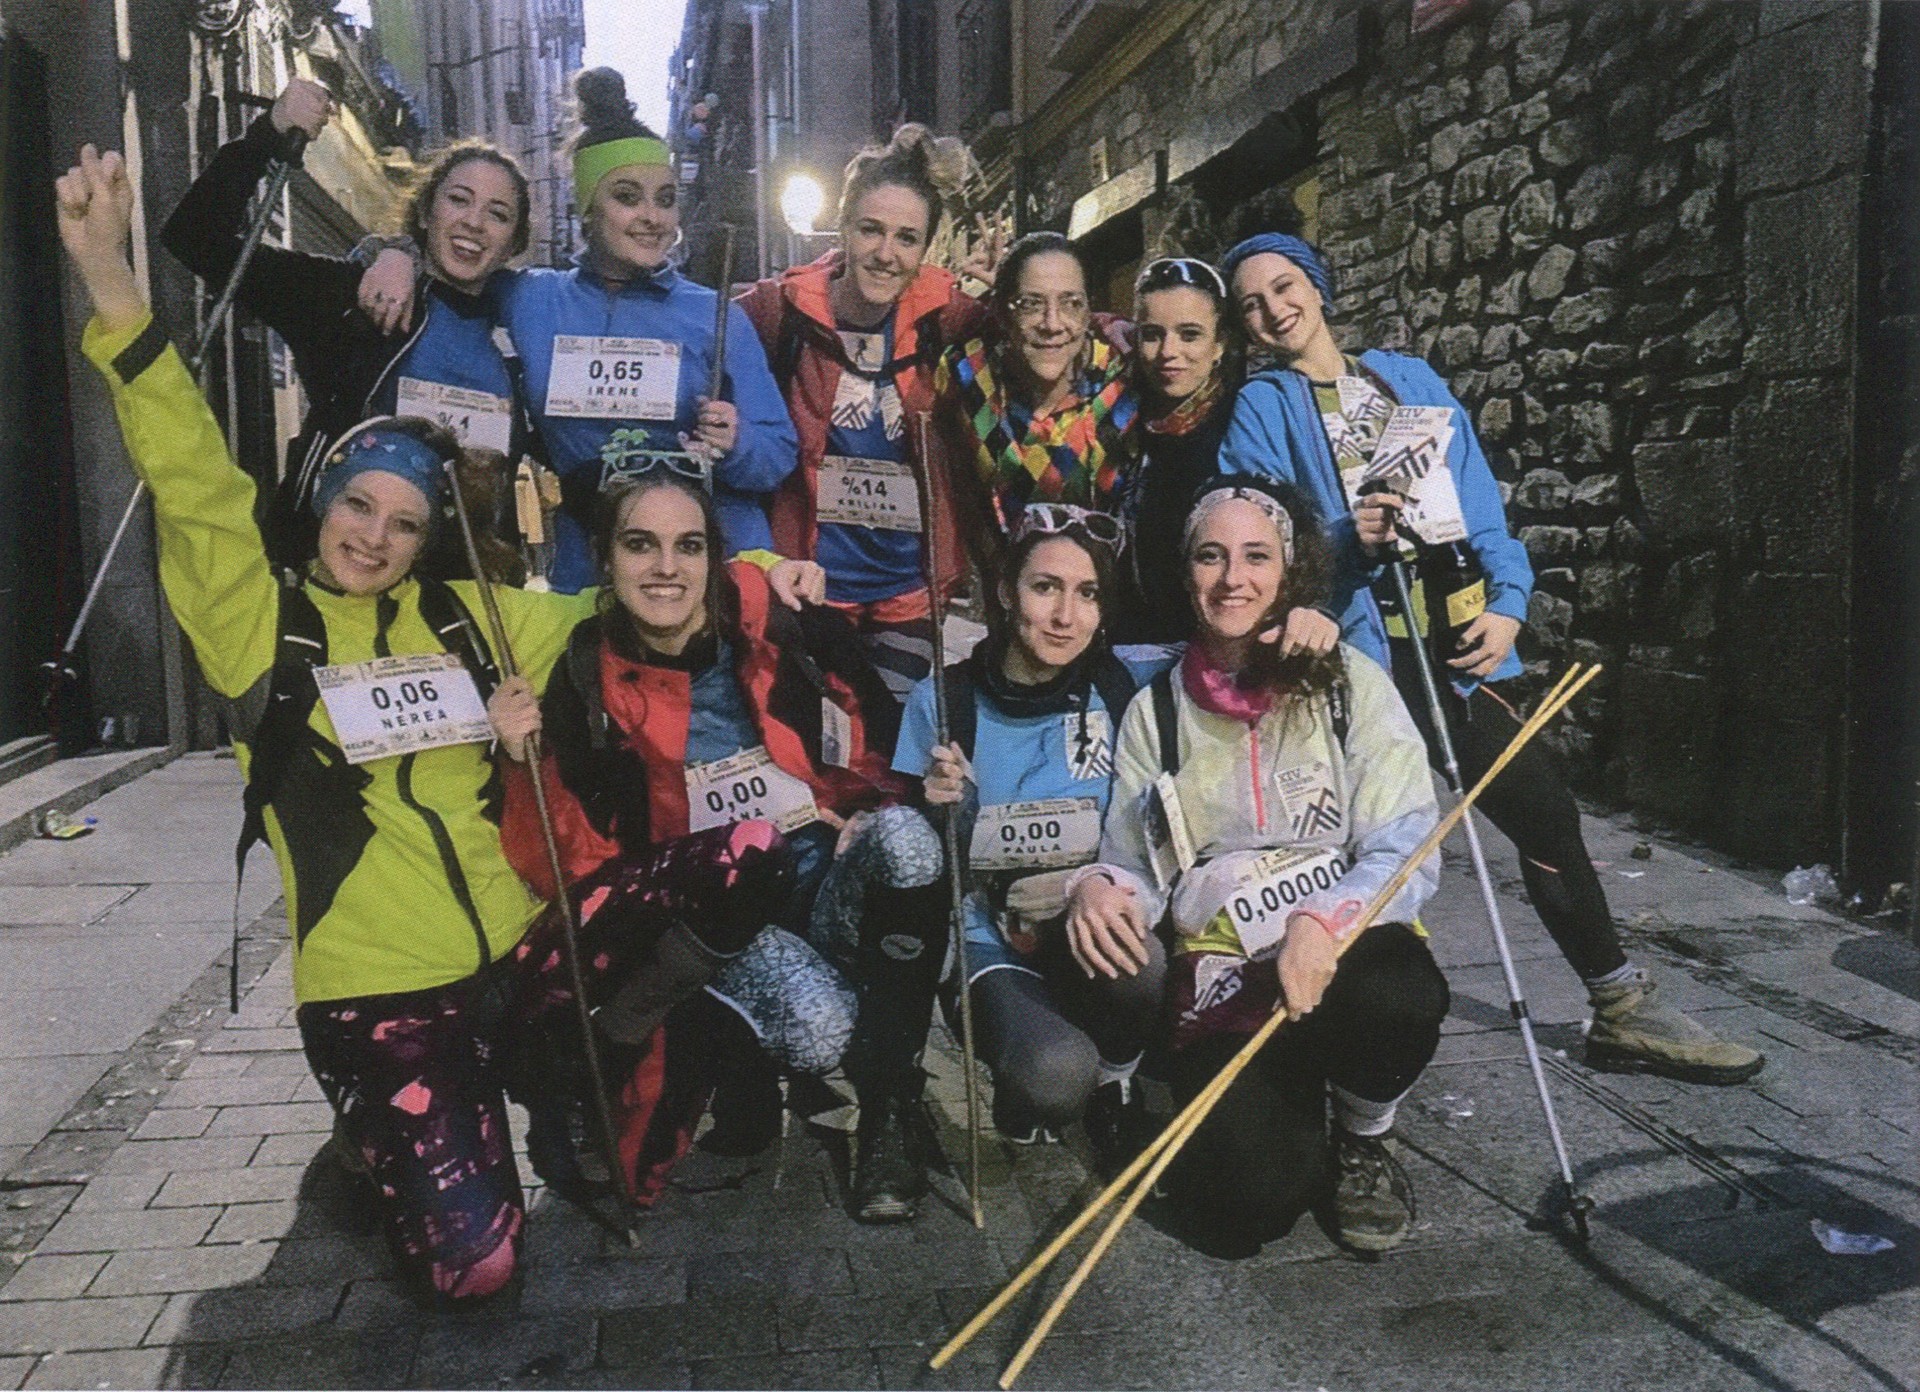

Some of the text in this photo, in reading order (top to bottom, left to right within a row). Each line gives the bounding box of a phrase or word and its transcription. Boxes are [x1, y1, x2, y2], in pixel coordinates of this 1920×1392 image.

[589, 360, 643, 384] 0,65
[588, 386, 639, 398] IRENE
[841, 476, 888, 498] %14
[371, 679, 439, 712] 0,06
[380, 708, 448, 730] NEREA
[706, 776, 767, 813] 0,00
[1001, 820, 1061, 846] 0,00
[1002, 843, 1061, 854] PAULA
[1234, 858, 1347, 923] 0,00000
